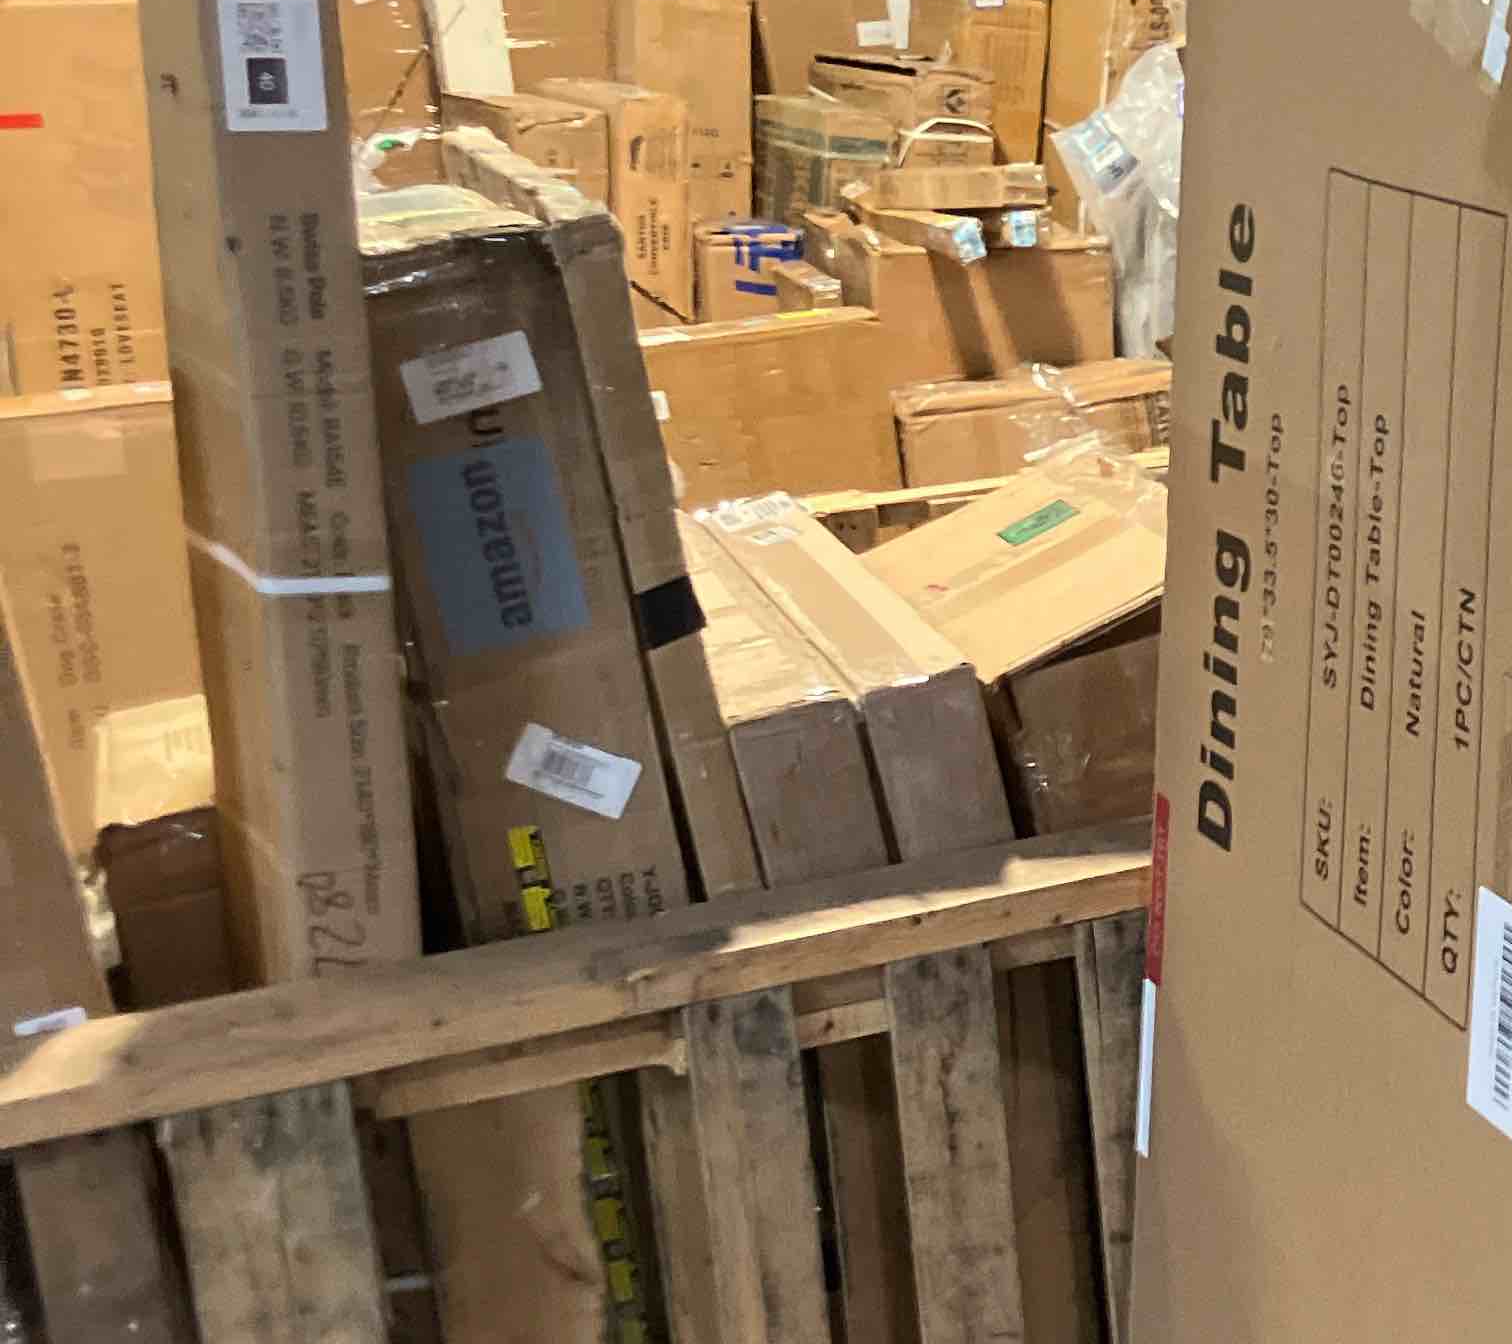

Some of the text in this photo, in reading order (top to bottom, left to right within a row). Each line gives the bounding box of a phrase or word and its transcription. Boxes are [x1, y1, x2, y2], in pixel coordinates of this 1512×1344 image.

[459, 460, 533, 630] amazon
[1196, 202, 1257, 853] Dining Table
[1352, 413, 1390, 907] Item: Dining Table-Top
[1313, 798, 1332, 883] SKU:
[1394, 609, 1426, 937] Color: Natural
[1439, 586, 1477, 977] QTY: 1PC/CTN
